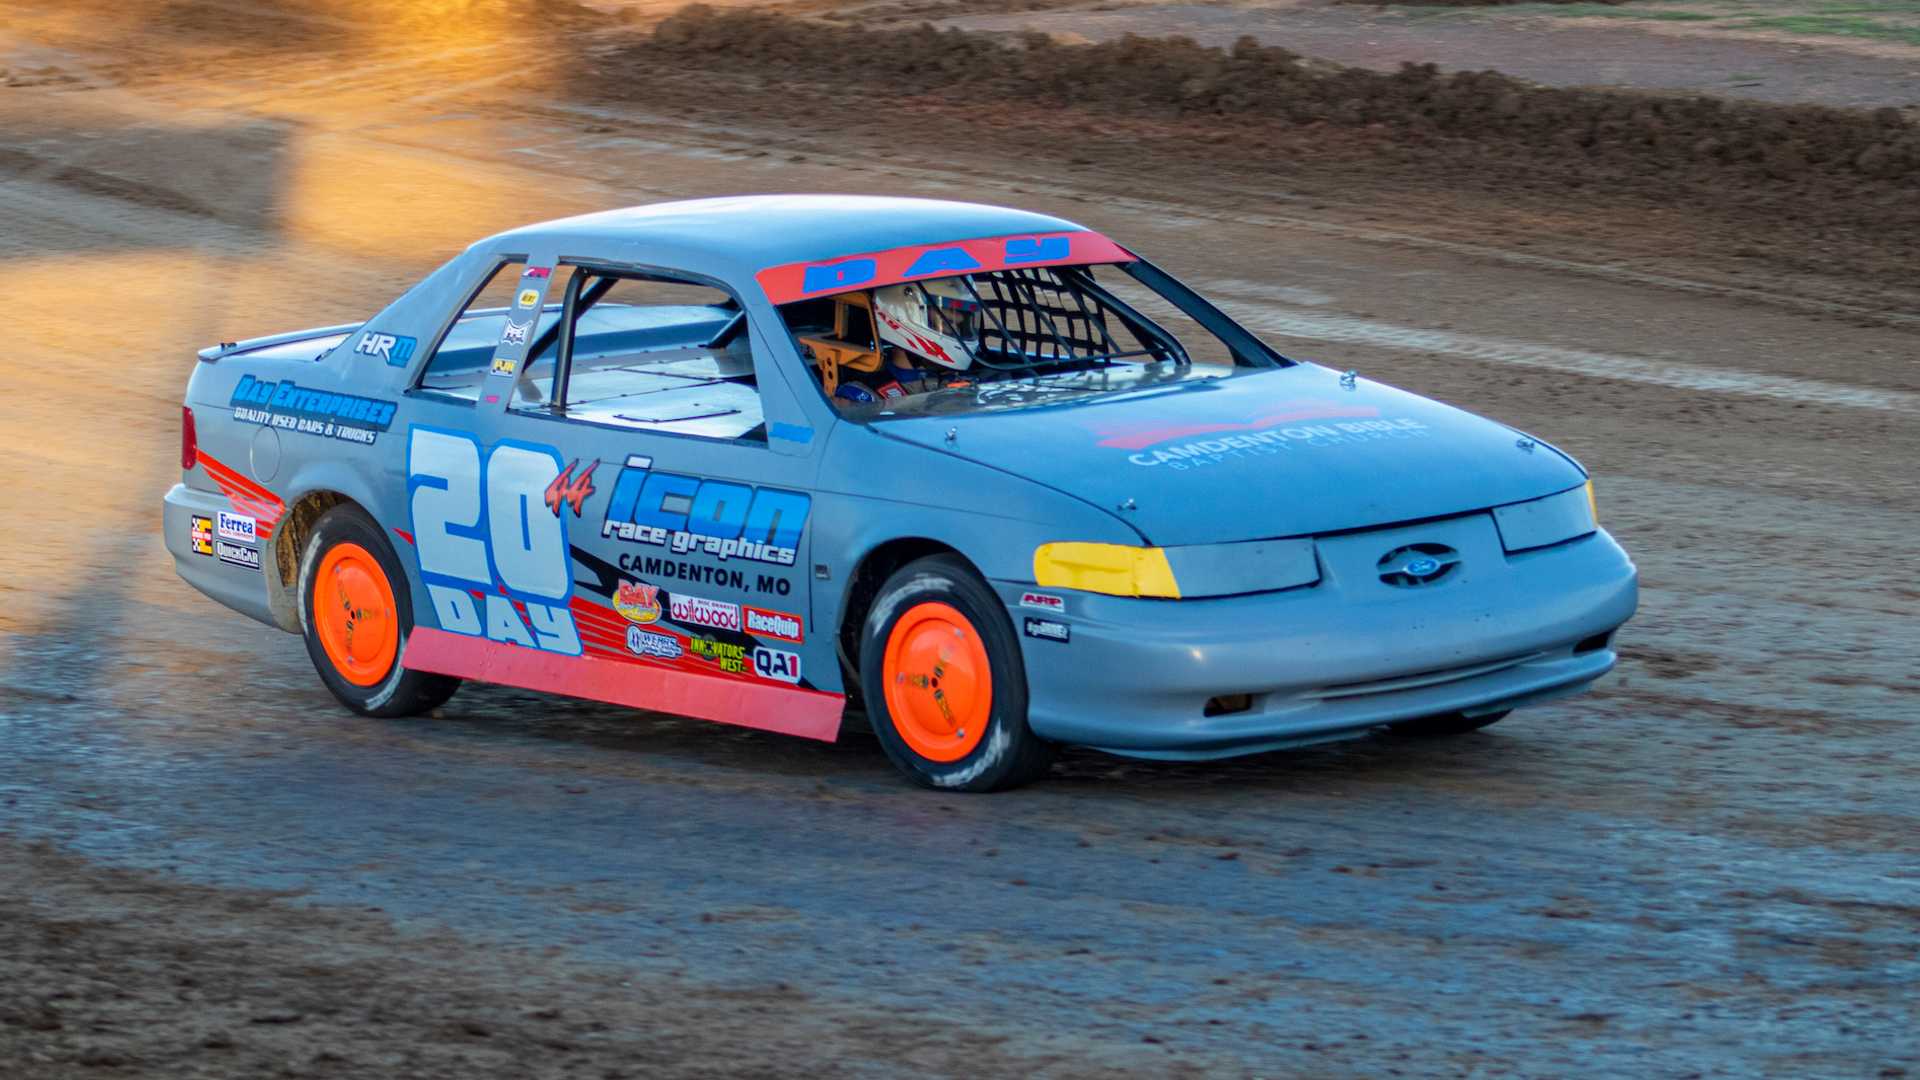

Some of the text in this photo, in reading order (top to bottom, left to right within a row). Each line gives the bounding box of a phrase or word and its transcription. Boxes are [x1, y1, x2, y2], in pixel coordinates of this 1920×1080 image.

[803, 237, 1070, 294] DAY
[234, 407, 272, 424] QUALITY
[272, 413, 297, 429] USED
[297, 417, 324, 434] CARS
[336, 425, 377, 445] TRUCKS
[269, 380, 398, 432] ENTERPRISES
[1128, 417, 1427, 466] CAMDENTON BIBLE
[1168, 429, 1431, 470] BAPTIST CHURCH
[545, 458, 600, 518] 44
[605, 453, 812, 548] icon
[220, 513, 253, 534] Ferrea
[407, 424, 572, 606] 20
[602, 519, 798, 567] race graphics
[618, 553, 791, 596] CAMDENTON, MO
[425, 584, 583, 656] DAY
[672, 598, 739, 629] wilwood
[748, 610, 799, 638] RaceQuip
[691, 637, 746, 659] INNOVATORS
[756, 649, 798, 677] QA1
